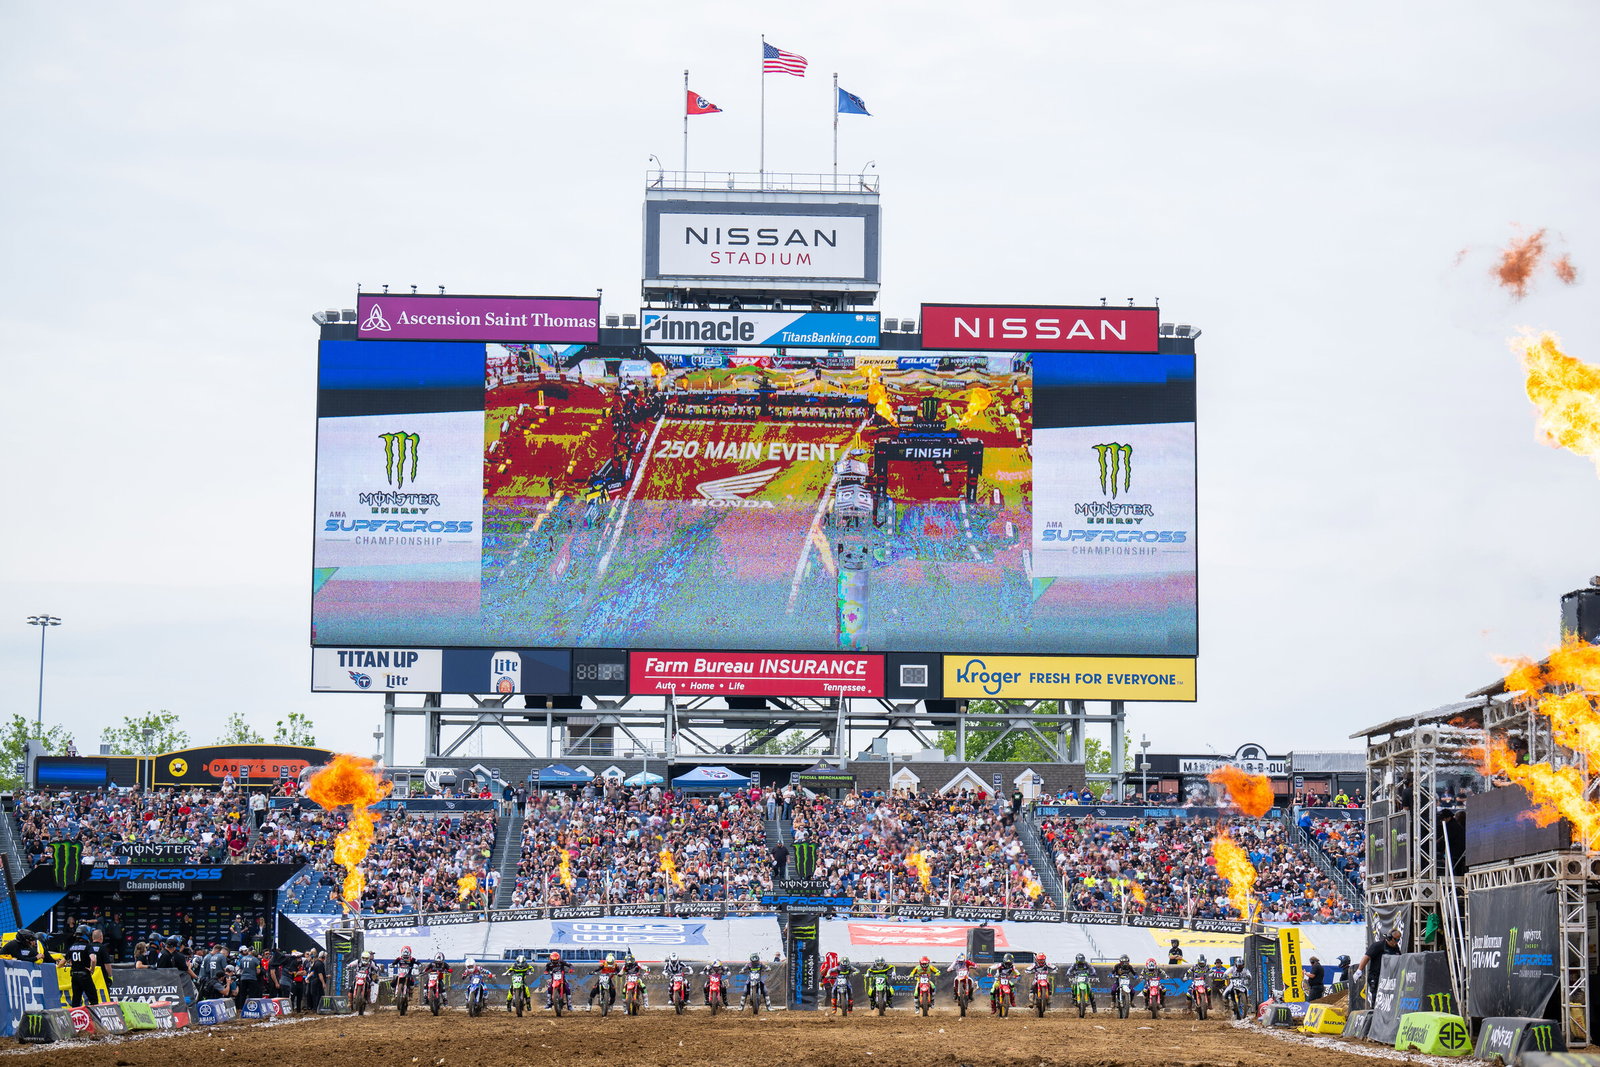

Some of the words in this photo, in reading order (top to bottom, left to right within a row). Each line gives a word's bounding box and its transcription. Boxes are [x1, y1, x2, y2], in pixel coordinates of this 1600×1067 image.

[686, 227, 837, 247] NISSAN
[710, 251, 812, 266] STADIUM
[397, 310, 481, 329] Ascension
[484, 312, 531, 328] Saint
[534, 312, 596, 330] Thomas
[645, 314, 754, 341] Pinnacle
[954, 316, 1126, 340] NISSAN
[782, 331, 876, 346] TitansBanking.com
[654, 440, 698, 459] 250
[704, 442, 762, 461] MAIN
[768, 443, 839, 462] EVENT
[905, 448, 952, 458] FINISH
[360, 491, 440, 506] MONSTER
[690, 499, 776, 509] HONDA
[1074, 502, 1154, 517] MONSTER
[324, 520, 473, 533] SUPERCROSS
[356, 536, 442, 546] CHAMPIONSHIP
[1042, 529, 1186, 543] SUPERCROSS
[1072, 546, 1158, 556] CHAMPIONSHIP
[337, 650, 394, 668] TITAN
[396, 652, 418, 668] UP
[494, 659, 518, 675] Lite
[645, 658, 688, 673] Farm
[694, 658, 754, 674] Bureau
[759, 659, 868, 676] INSURANCE
[385, 674, 408, 688] Lite
[957, 659, 1022, 695] Kroger
[1030, 672, 1070, 684] FRESH
[1075, 672, 1102, 685] FOR
[1107, 673, 1176, 686] EVERYONE
[656, 681, 676, 690] Auto
[690, 682, 714, 690] Home
[728, 682, 744, 690] Life
[823, 683, 866, 692] Tennessee
[214, 764, 266, 772] DADY'S
[272, 764, 306, 774] DGS
[122, 844, 193, 856] MONSTER
[89, 868, 223, 880] SUPERCROSS
[126, 882, 185, 891] Championship
[780, 880, 829, 890] MONSTER
[760, 896, 854, 906] SUPERCROSS
[1522, 929, 1542, 942] MONSTER
[72, 952, 81, 962] 01
[1287, 932, 1300, 998] LEADER
[109, 987, 124, 995] CKY
[126, 986, 178, 995] MOUNTAIN
